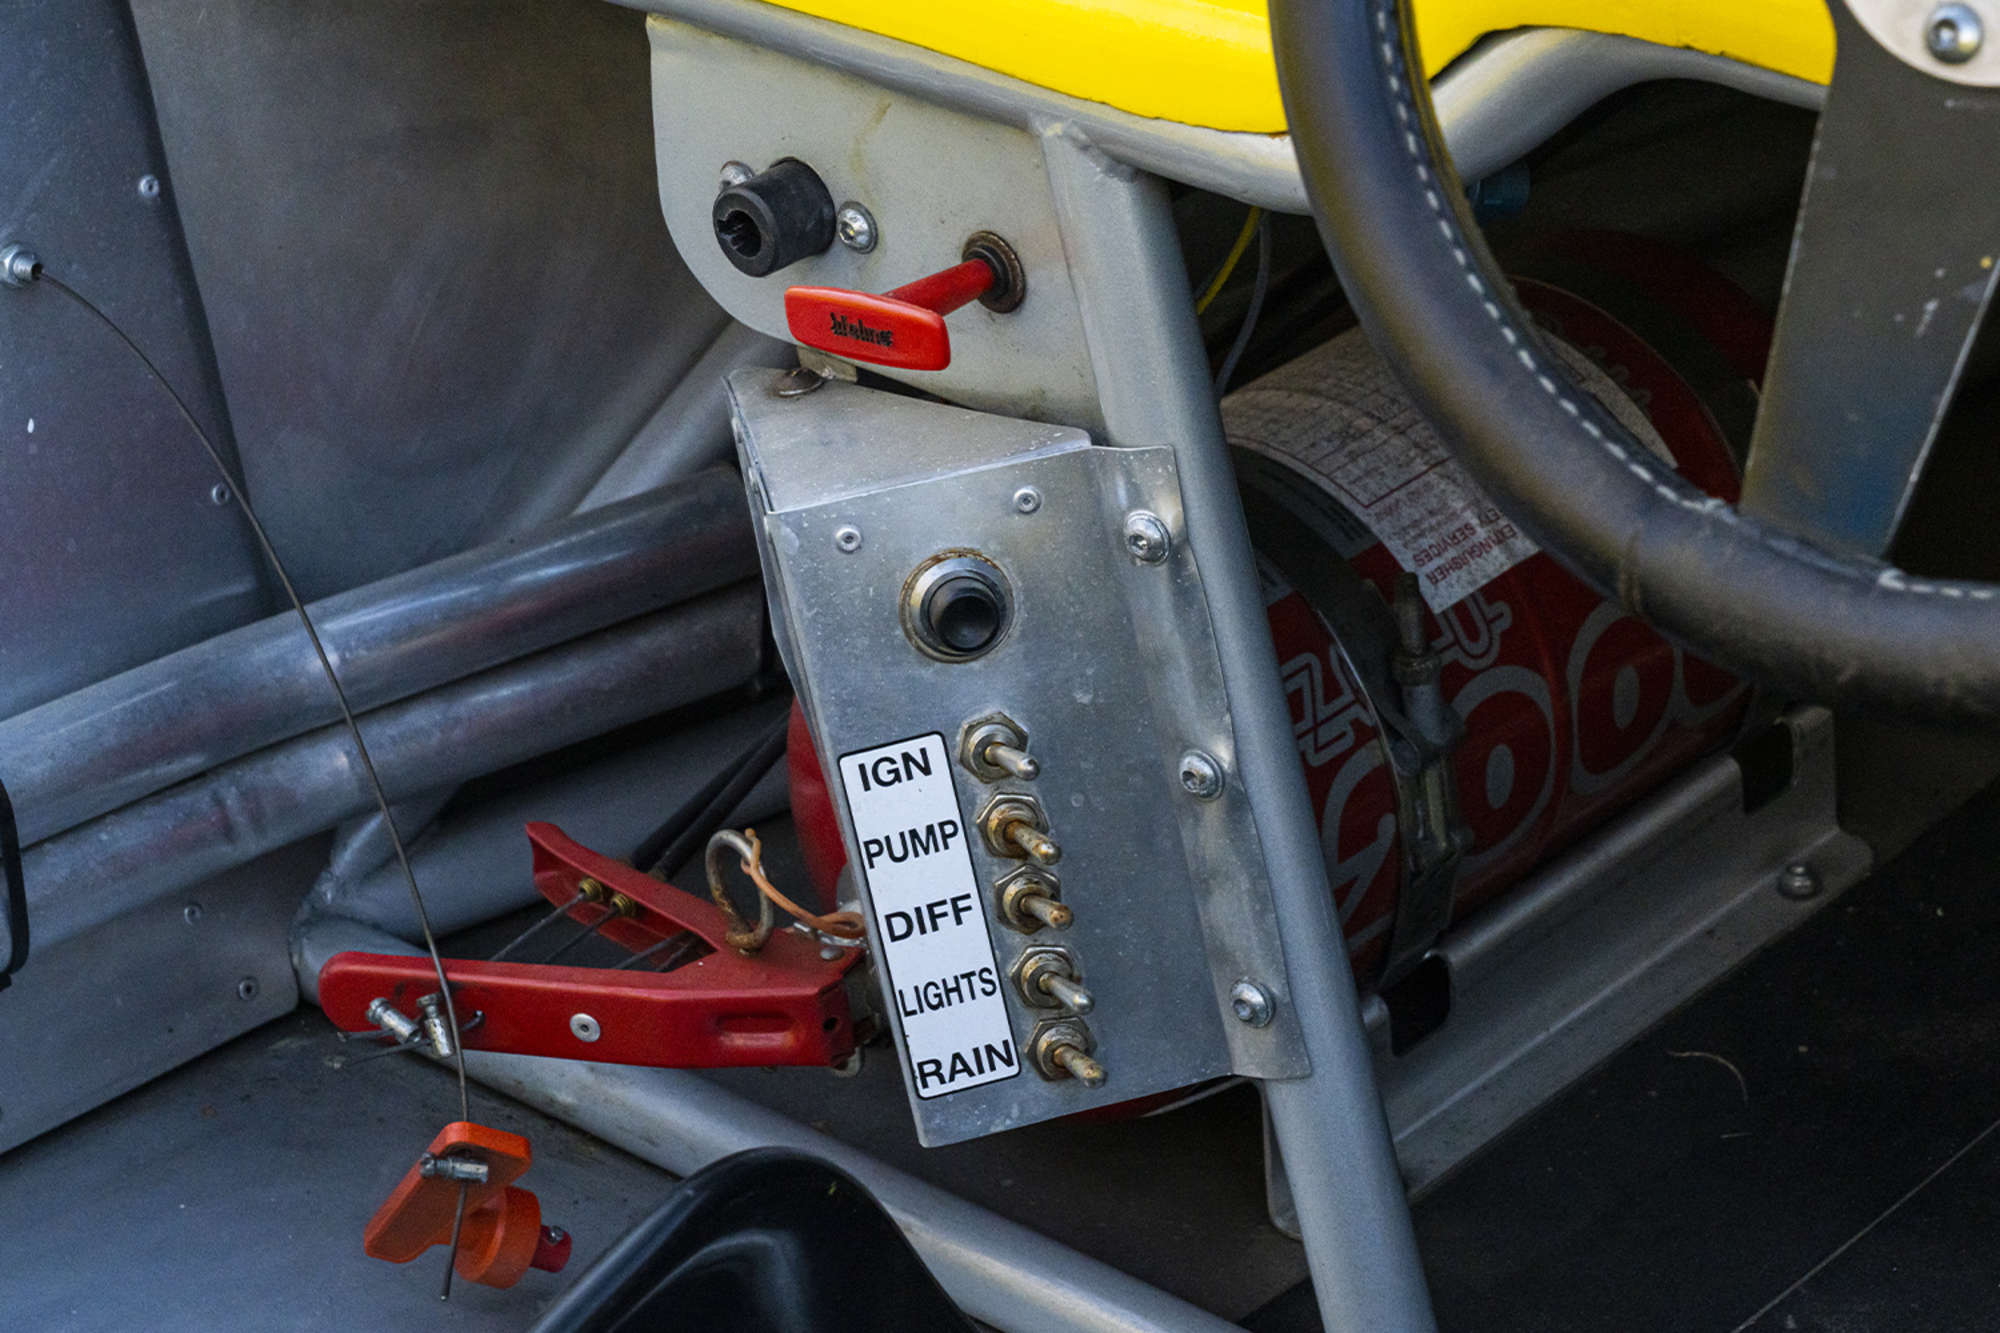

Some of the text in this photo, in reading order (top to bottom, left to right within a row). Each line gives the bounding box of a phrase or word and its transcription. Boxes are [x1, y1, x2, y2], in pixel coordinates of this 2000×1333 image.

[1411, 519, 1478, 570] SERVICES
[1424, 521, 1518, 588] EXTINGUISHER
[858, 743, 933, 793] IGN
[863, 818, 960, 870] PUMP
[884, 892, 974, 944] DIFF
[898, 966, 998, 1019] LIGHTS
[915, 1038, 1016, 1091] RAIN
